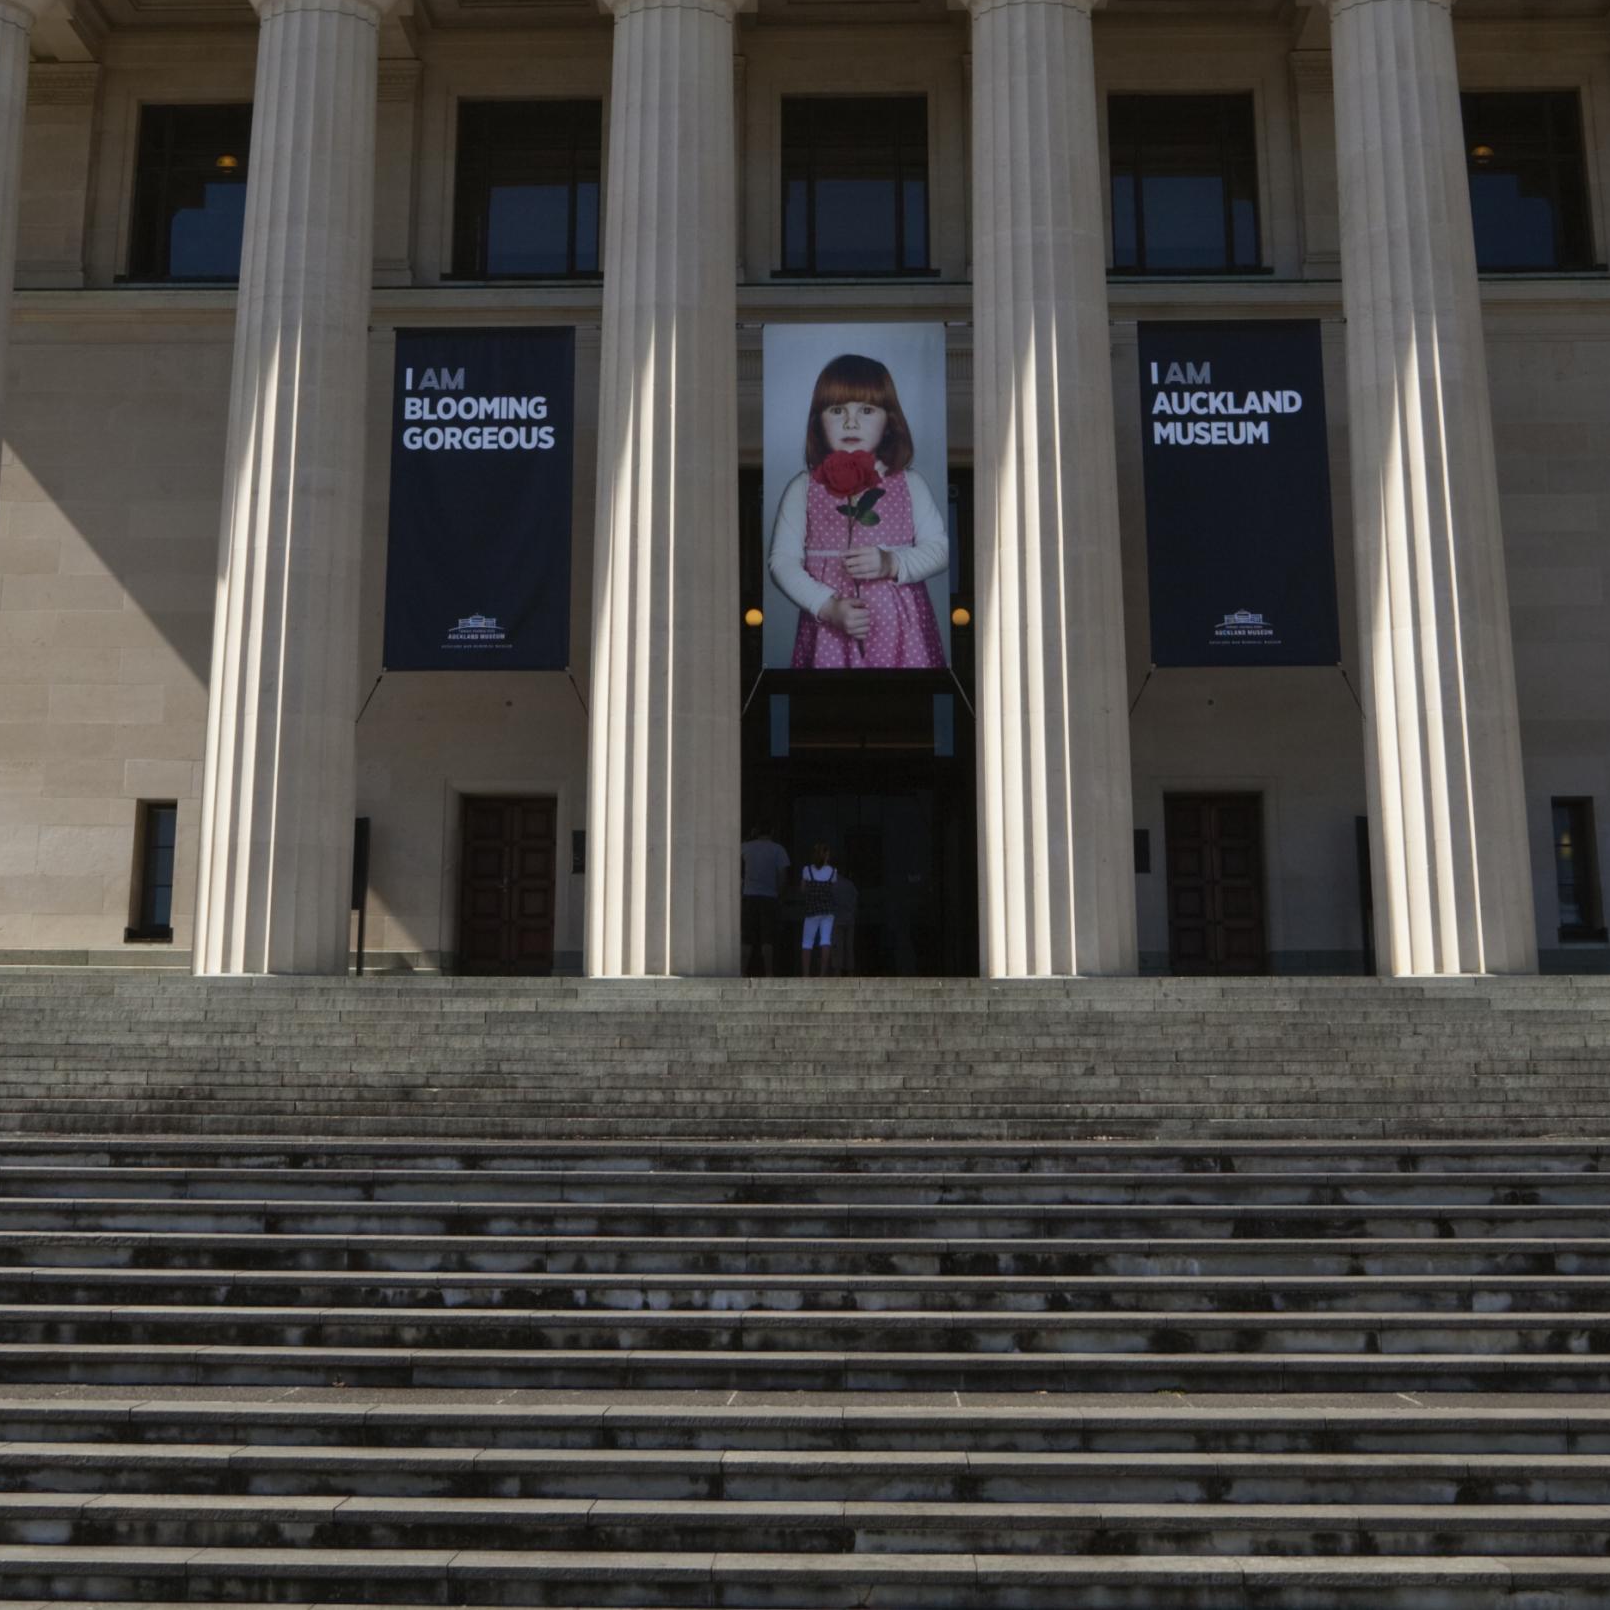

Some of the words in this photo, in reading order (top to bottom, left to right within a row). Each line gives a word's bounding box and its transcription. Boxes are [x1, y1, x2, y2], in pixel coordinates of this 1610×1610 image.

[405, 367, 413, 390] I
[418, 367, 465, 390] AM
[1150, 362, 1159, 385] I
[1164, 362, 1211, 385] AM
[404, 396, 547, 420] BLOOMING
[1152, 390, 1302, 415] AUCKLAND
[403, 426, 555, 450] GORGEOUS
[1153, 421, 1269, 445] MUSEUM
